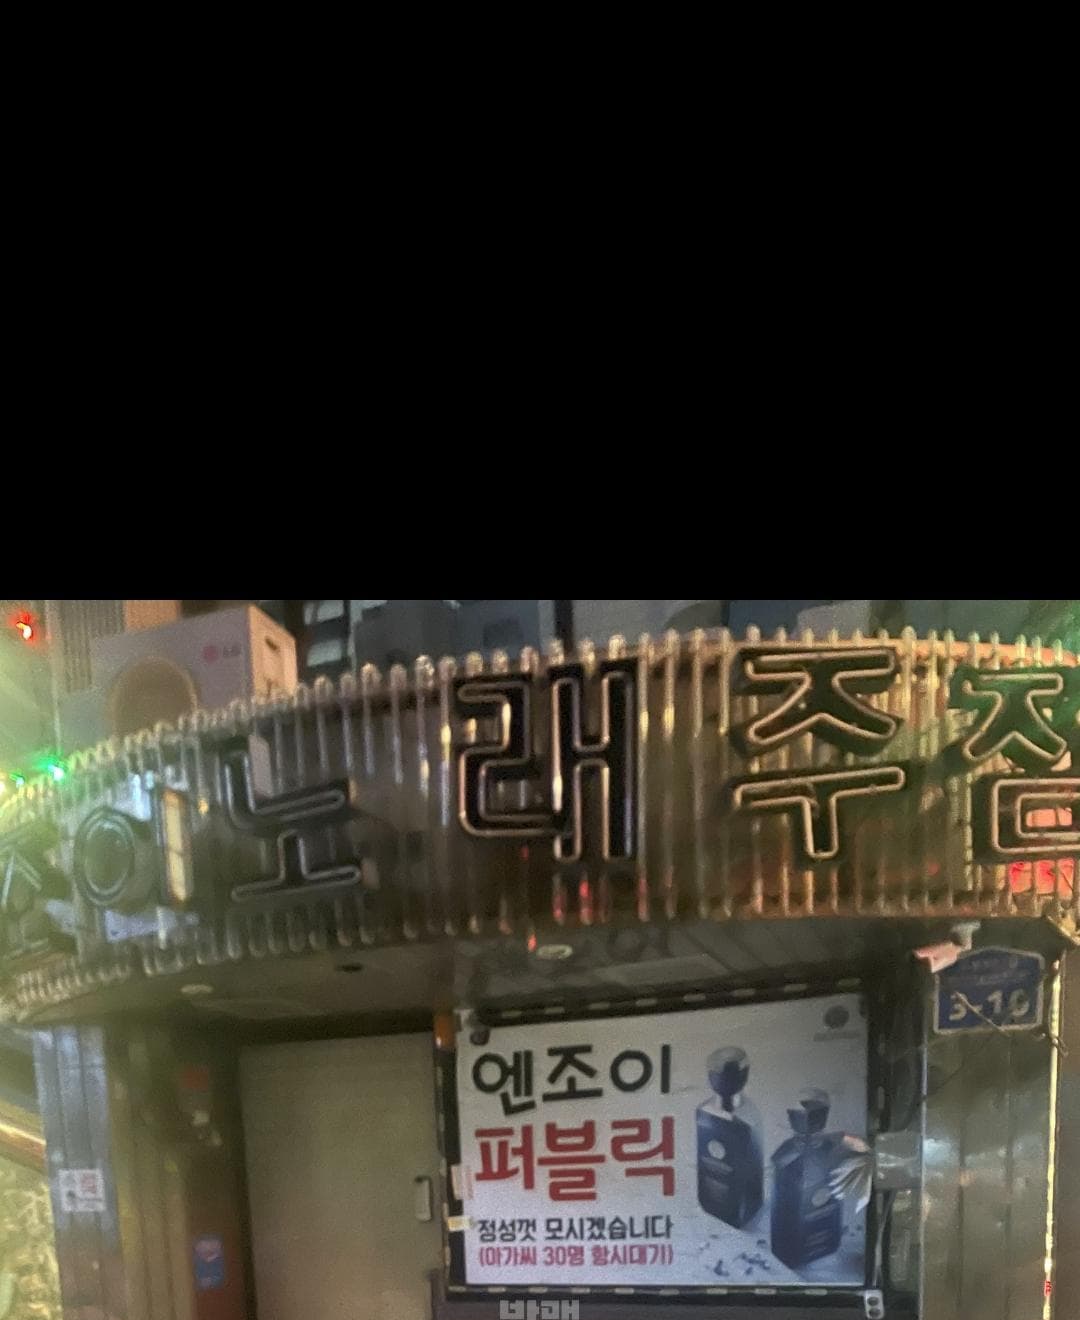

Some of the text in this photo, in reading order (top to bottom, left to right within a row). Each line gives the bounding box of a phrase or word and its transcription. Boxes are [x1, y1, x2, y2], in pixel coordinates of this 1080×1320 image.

[472, 1044, 672, 1117] 엔조이
[475, 1116, 676, 1202] 퍼블릭
[478, 1214, 674, 1242] 정성껏 모시겠습니다
[479, 1244, 674, 1267] (아가씨 30명 항시대기)
